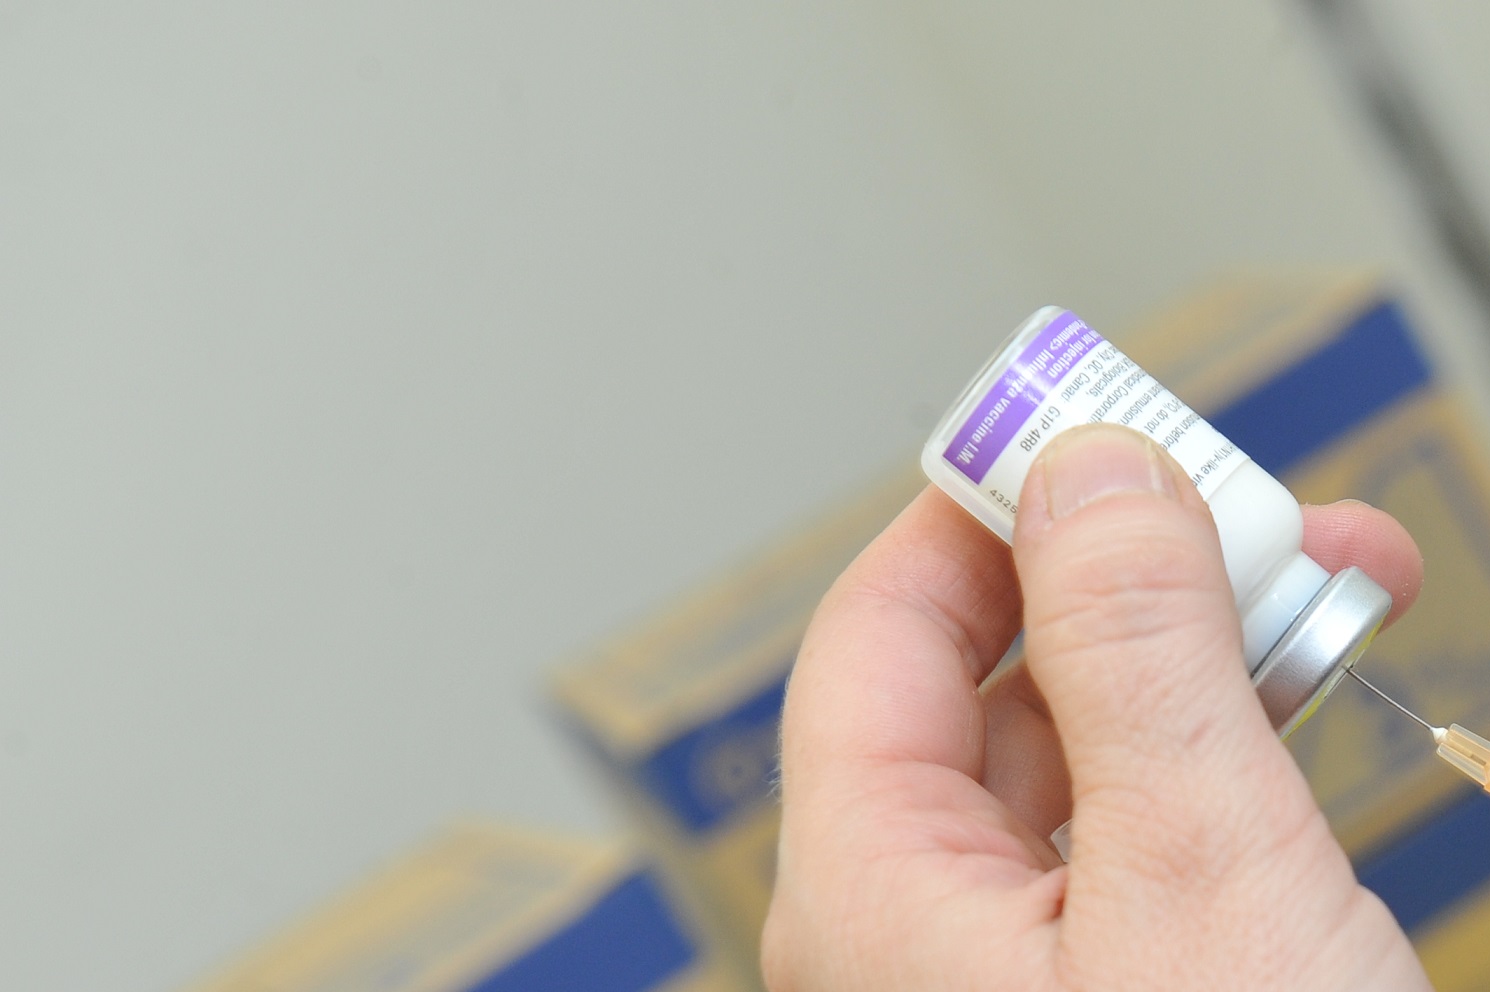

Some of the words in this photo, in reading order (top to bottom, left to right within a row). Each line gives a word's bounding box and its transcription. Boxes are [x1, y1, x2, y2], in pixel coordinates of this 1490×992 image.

[1046, 341, 1089, 379] injection
[1006, 349, 1055, 398] Influnza
[1085, 362, 1128, 397] Biologicals,
[1058, 373, 1091, 402] Canad
[1040, 406, 1060, 430] G1P
[1087, 386, 1128, 424] Corporati
[1156, 409, 1168, 421] do
[971, 398, 1011, 443] vaccine
[1144, 418, 1160, 433] not
[1020, 429, 1040, 452] 4R8
[1160, 427, 1186, 451] before
[956, 441, 979, 464] I.M.
